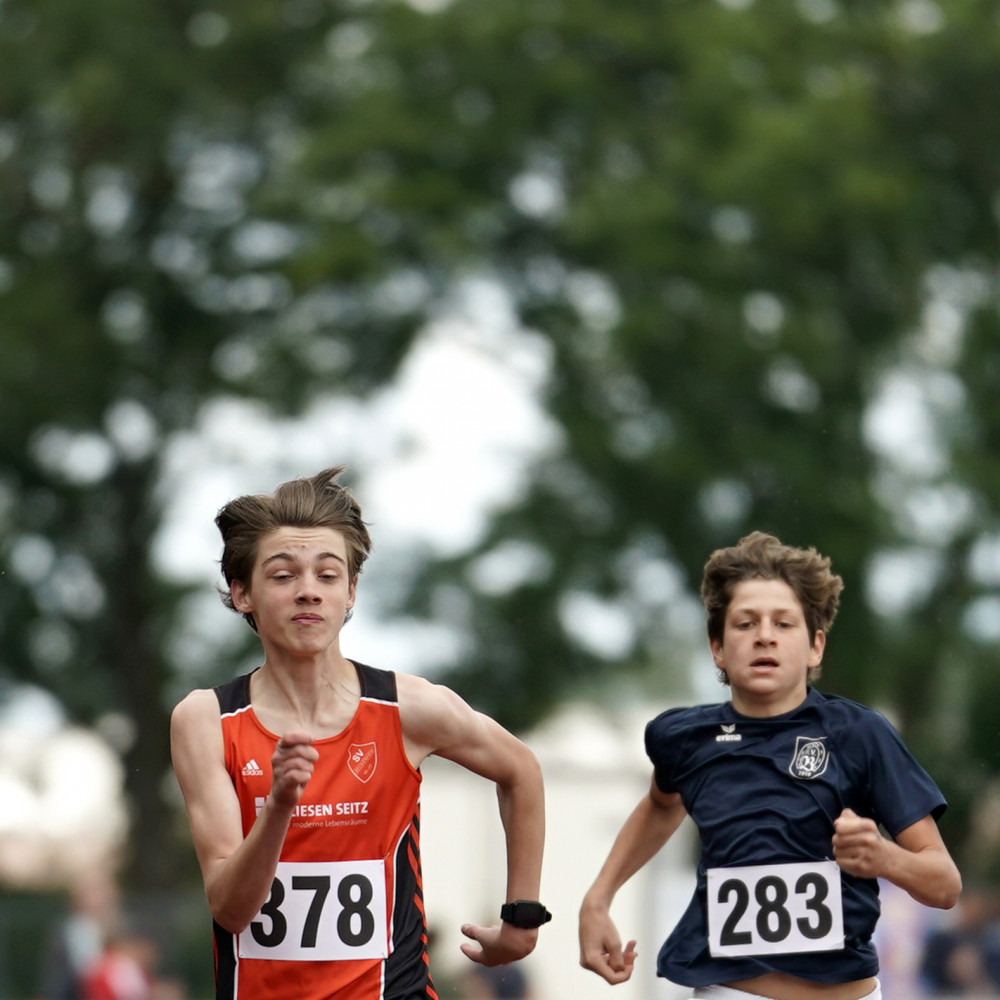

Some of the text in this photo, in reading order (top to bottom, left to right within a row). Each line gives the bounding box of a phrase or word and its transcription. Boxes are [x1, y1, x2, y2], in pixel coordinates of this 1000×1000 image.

[352, 748, 364, 763] SV
[290, 801, 369, 817] IESEN SEITZ
[250, 873, 375, 948] 378
[717, 872, 833, 947] 283
